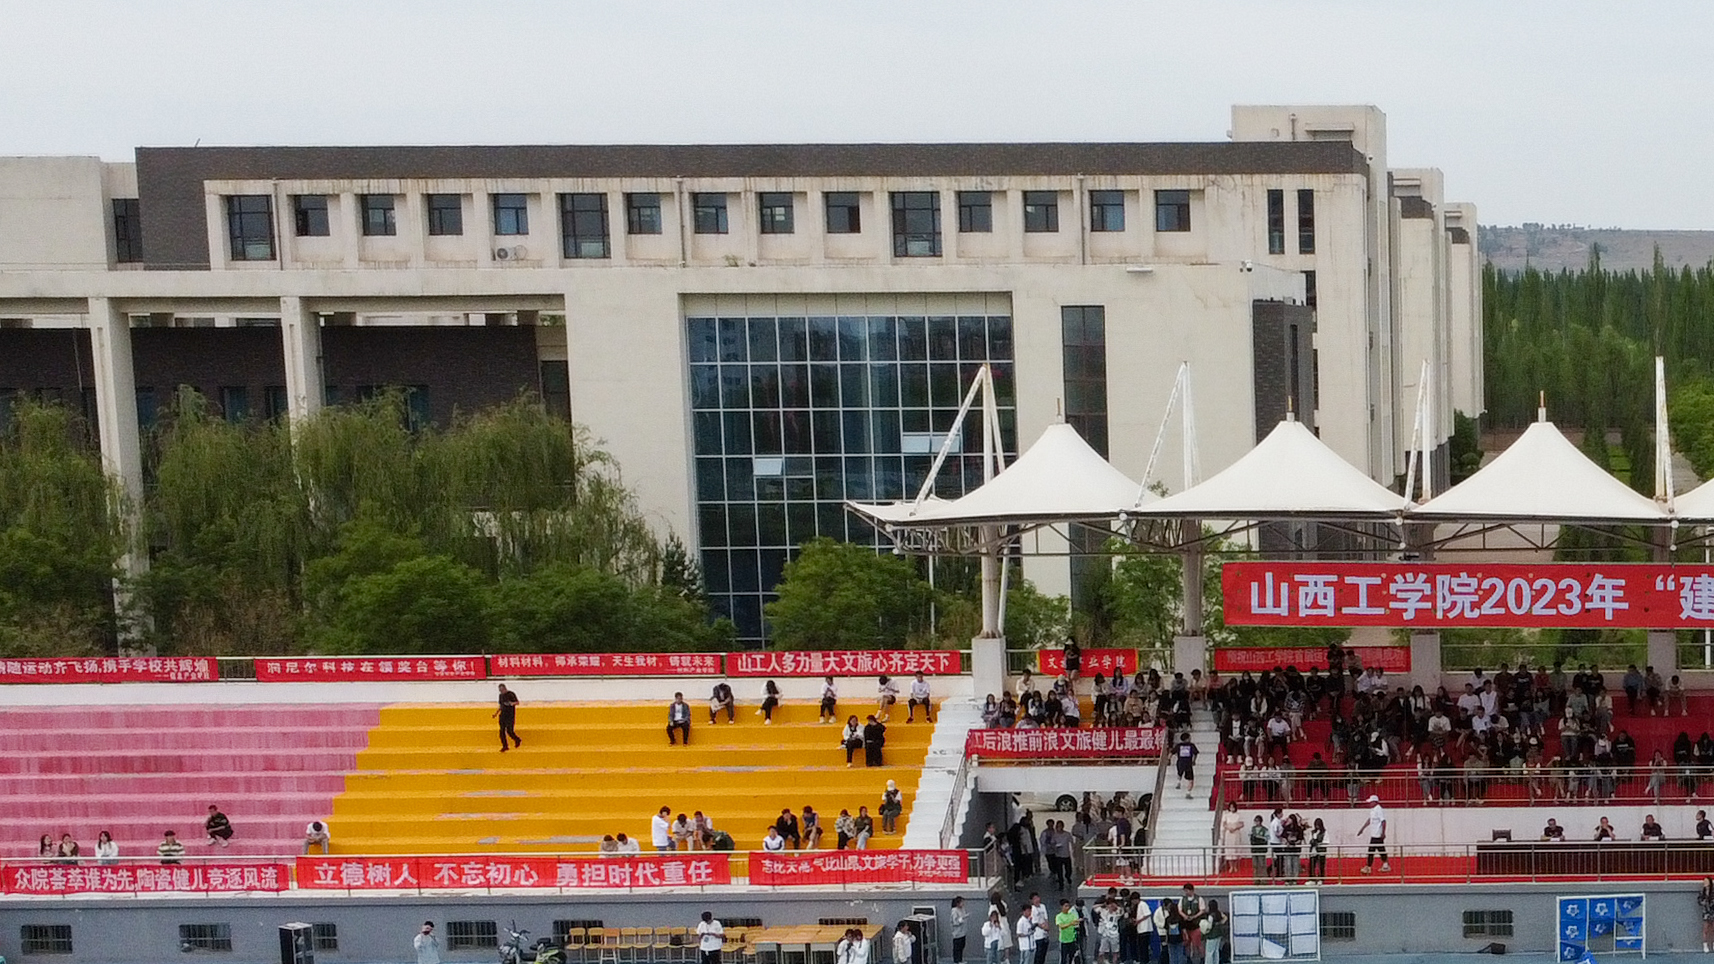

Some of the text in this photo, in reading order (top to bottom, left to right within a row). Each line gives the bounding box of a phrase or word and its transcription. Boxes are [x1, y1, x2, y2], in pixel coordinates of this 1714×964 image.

[1250, 571, 1629, 621] 山西工学院2023年
[737, 651, 951, 673] 山工人多力量大文旅心齐定天下
[314, 859, 713, 887] 立德树人 不忘初心 勇担时代重任
